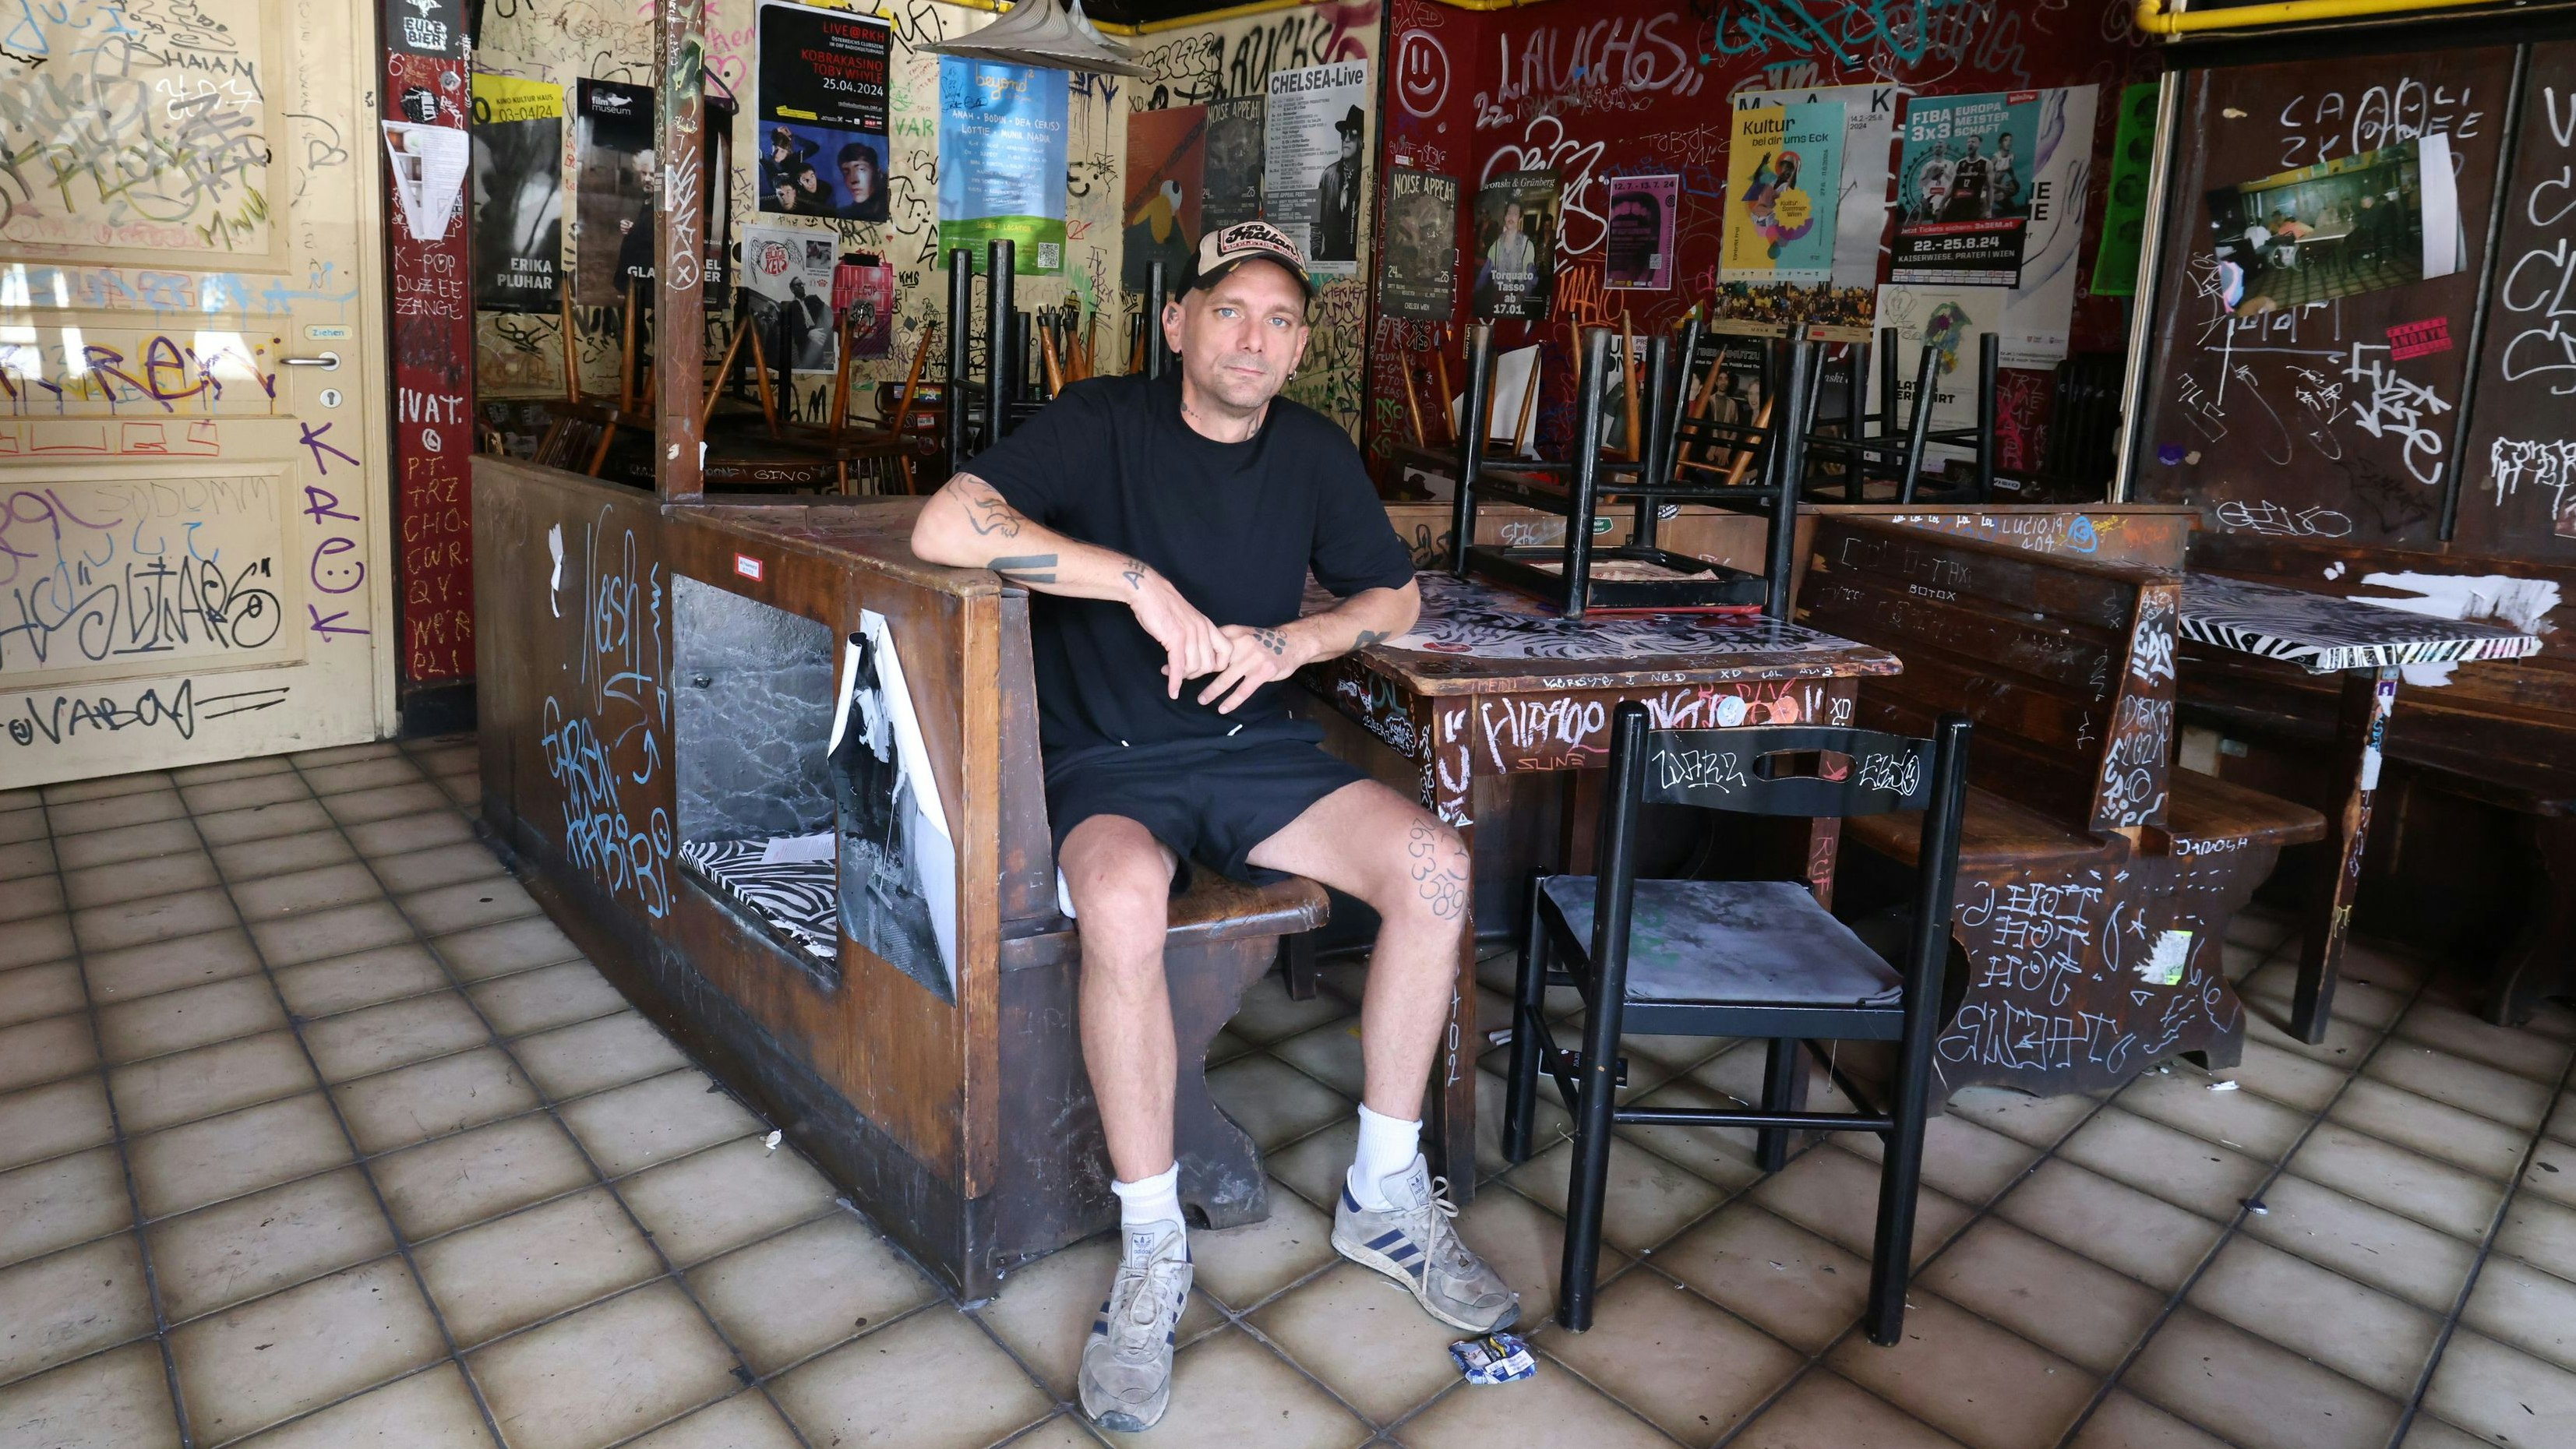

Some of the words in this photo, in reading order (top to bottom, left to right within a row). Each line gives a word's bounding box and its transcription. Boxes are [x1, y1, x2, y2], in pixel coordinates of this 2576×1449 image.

[404, 17, 445, 35] EULE
[823, 21, 885, 42] LIVE@RKH
[407, 31, 443, 47] BIER
[860, 41, 884, 50] CLUBSZENE
[801, 49, 884, 72] KOBRAKASINO
[813, 62, 842, 77] TOBY
[845, 69, 883, 84] WHYLE
[1271, 66, 1364, 95] CHELSEA-Live
[823, 77, 884, 97] 25.04.2024
[512, 95, 535, 104] KULTUR
[536, 93, 553, 102] HAUS
[591, 96, 609, 107] film
[1871, 87, 1893, 113] K
[499, 104, 553, 122] 03-04/24
[591, 104, 631, 116] museum
[1206, 102, 1230, 131] NOISE
[1911, 108, 1951, 125] FIBA
[1955, 102, 2002, 116] EUROPA
[894, 116, 934, 138] VAR
[952, 110, 974, 121] ANAH
[983, 112, 1007, 125] BODIN
[1015, 118, 1032, 129] DEA
[1743, 118, 1796, 136] Kultur
[1954, 111, 2010, 127] MEISTER
[962, 124, 990, 136] LOTTIE
[1911, 123, 1951, 143] 3x3
[1953, 124, 2001, 138] SCHAFT
[1784, 135, 1806, 144] ums
[1808, 133, 1829, 143] Eck
[1393, 174, 1421, 200] NOISE
[1520, 178, 1555, 189] Grünberg
[1003, 224, 1032, 232] LOCATION
[1900, 225, 1918, 234] Jetzt
[1918, 224, 1944, 234] Tickets
[1913, 236, 2000, 252] 22.-25.8.24
[765, 250, 785, 261] BLACK
[1955, 251, 1986, 260] PRATER
[1992, 249, 2015, 258] WIEN
[510, 258, 552, 273] ERIKA
[764, 259, 788, 275] KEYS
[497, 274, 552, 291] PLUHAR
[1491, 270, 1534, 282] Torquato
[1497, 281, 1526, 292] Tasso
[1504, 294, 1516, 304] ab
[1493, 305, 1526, 316] 17.01.
[312, 328, 345, 337] Ziehen
[753, 470, 811, 481] GINO
[1909, 583, 1957, 601] BOTOX
